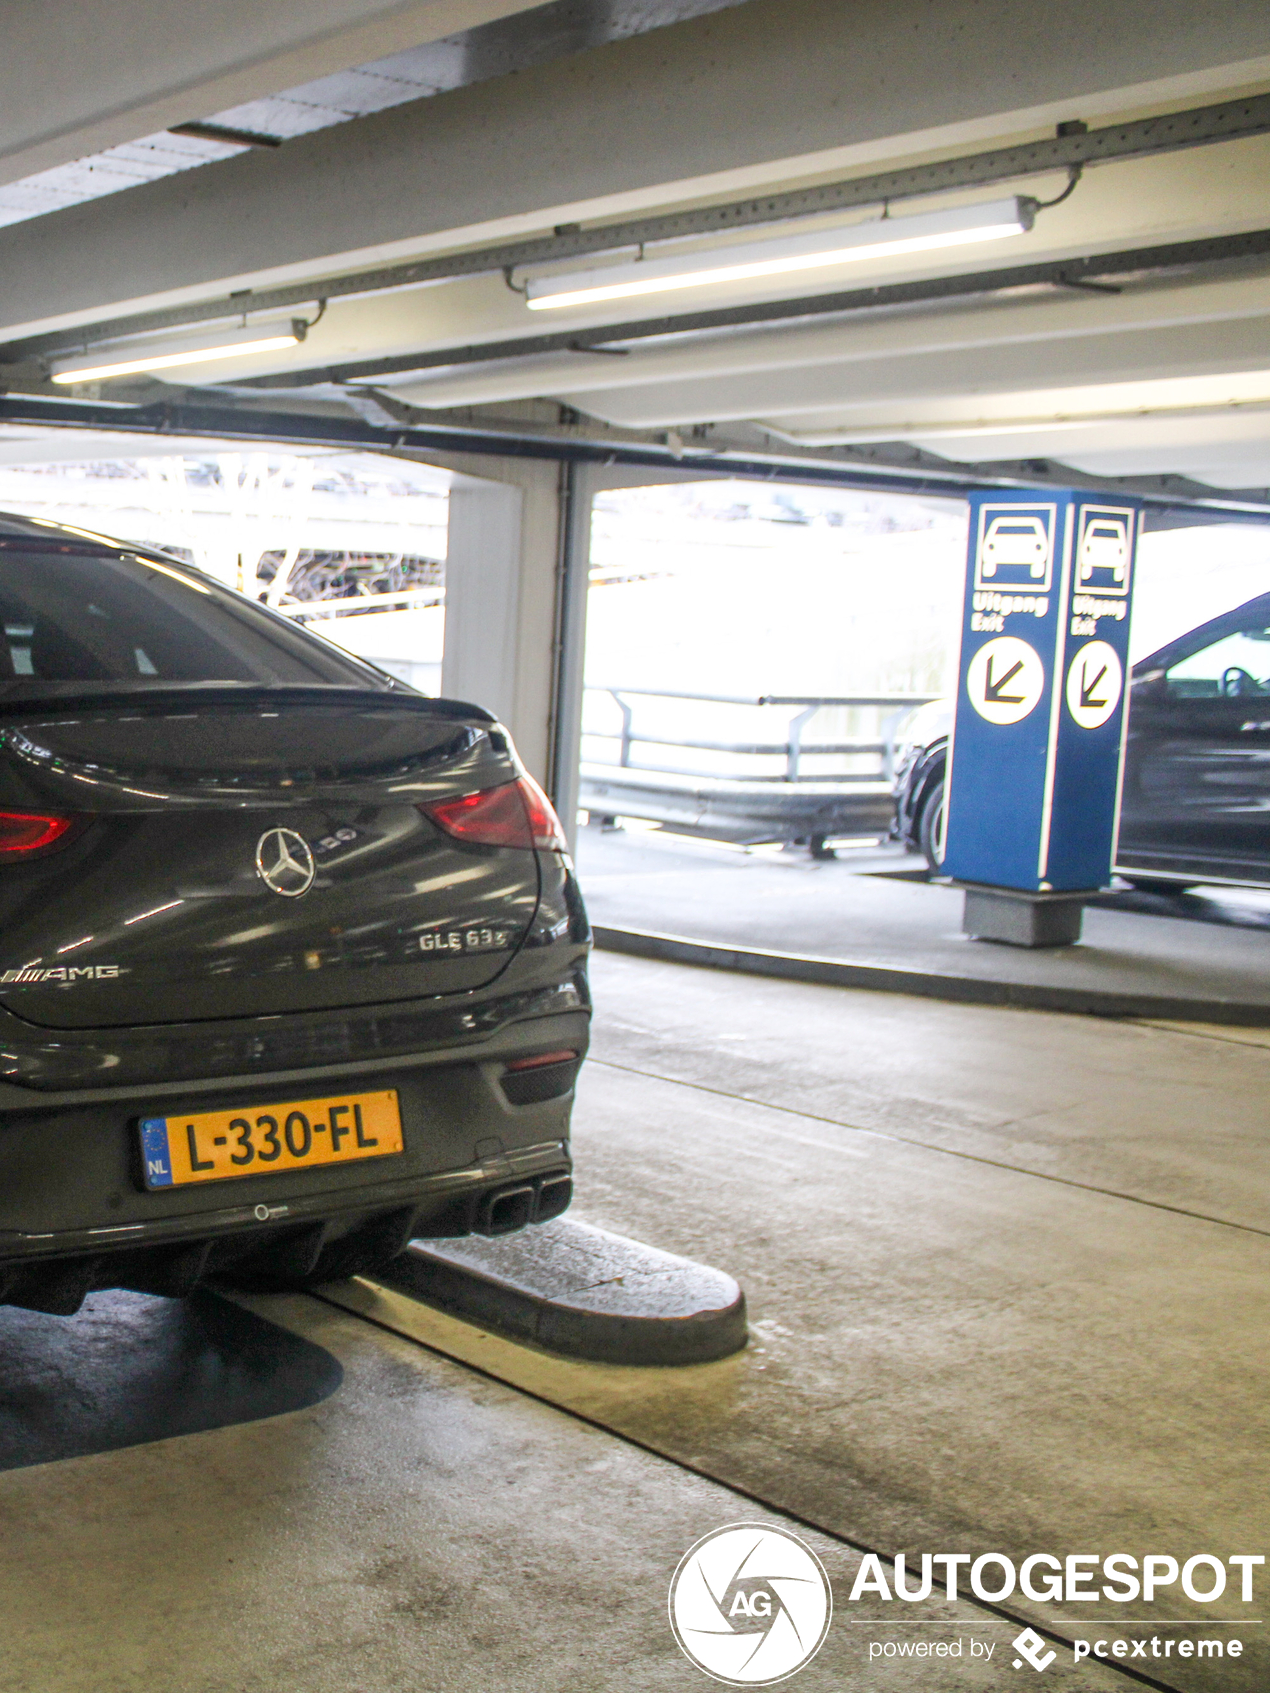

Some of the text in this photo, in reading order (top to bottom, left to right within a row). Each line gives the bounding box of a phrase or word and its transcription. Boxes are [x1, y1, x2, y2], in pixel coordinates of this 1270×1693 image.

[973, 591, 1049, 617] Uitgang
[1072, 594, 1127, 621] Uitgang
[971, 612, 1005, 632] Exit
[1070, 616, 1097, 636] Exit
[419, 932, 462, 952] GLE
[148, 1103, 379, 1175] NL L-330-FL
